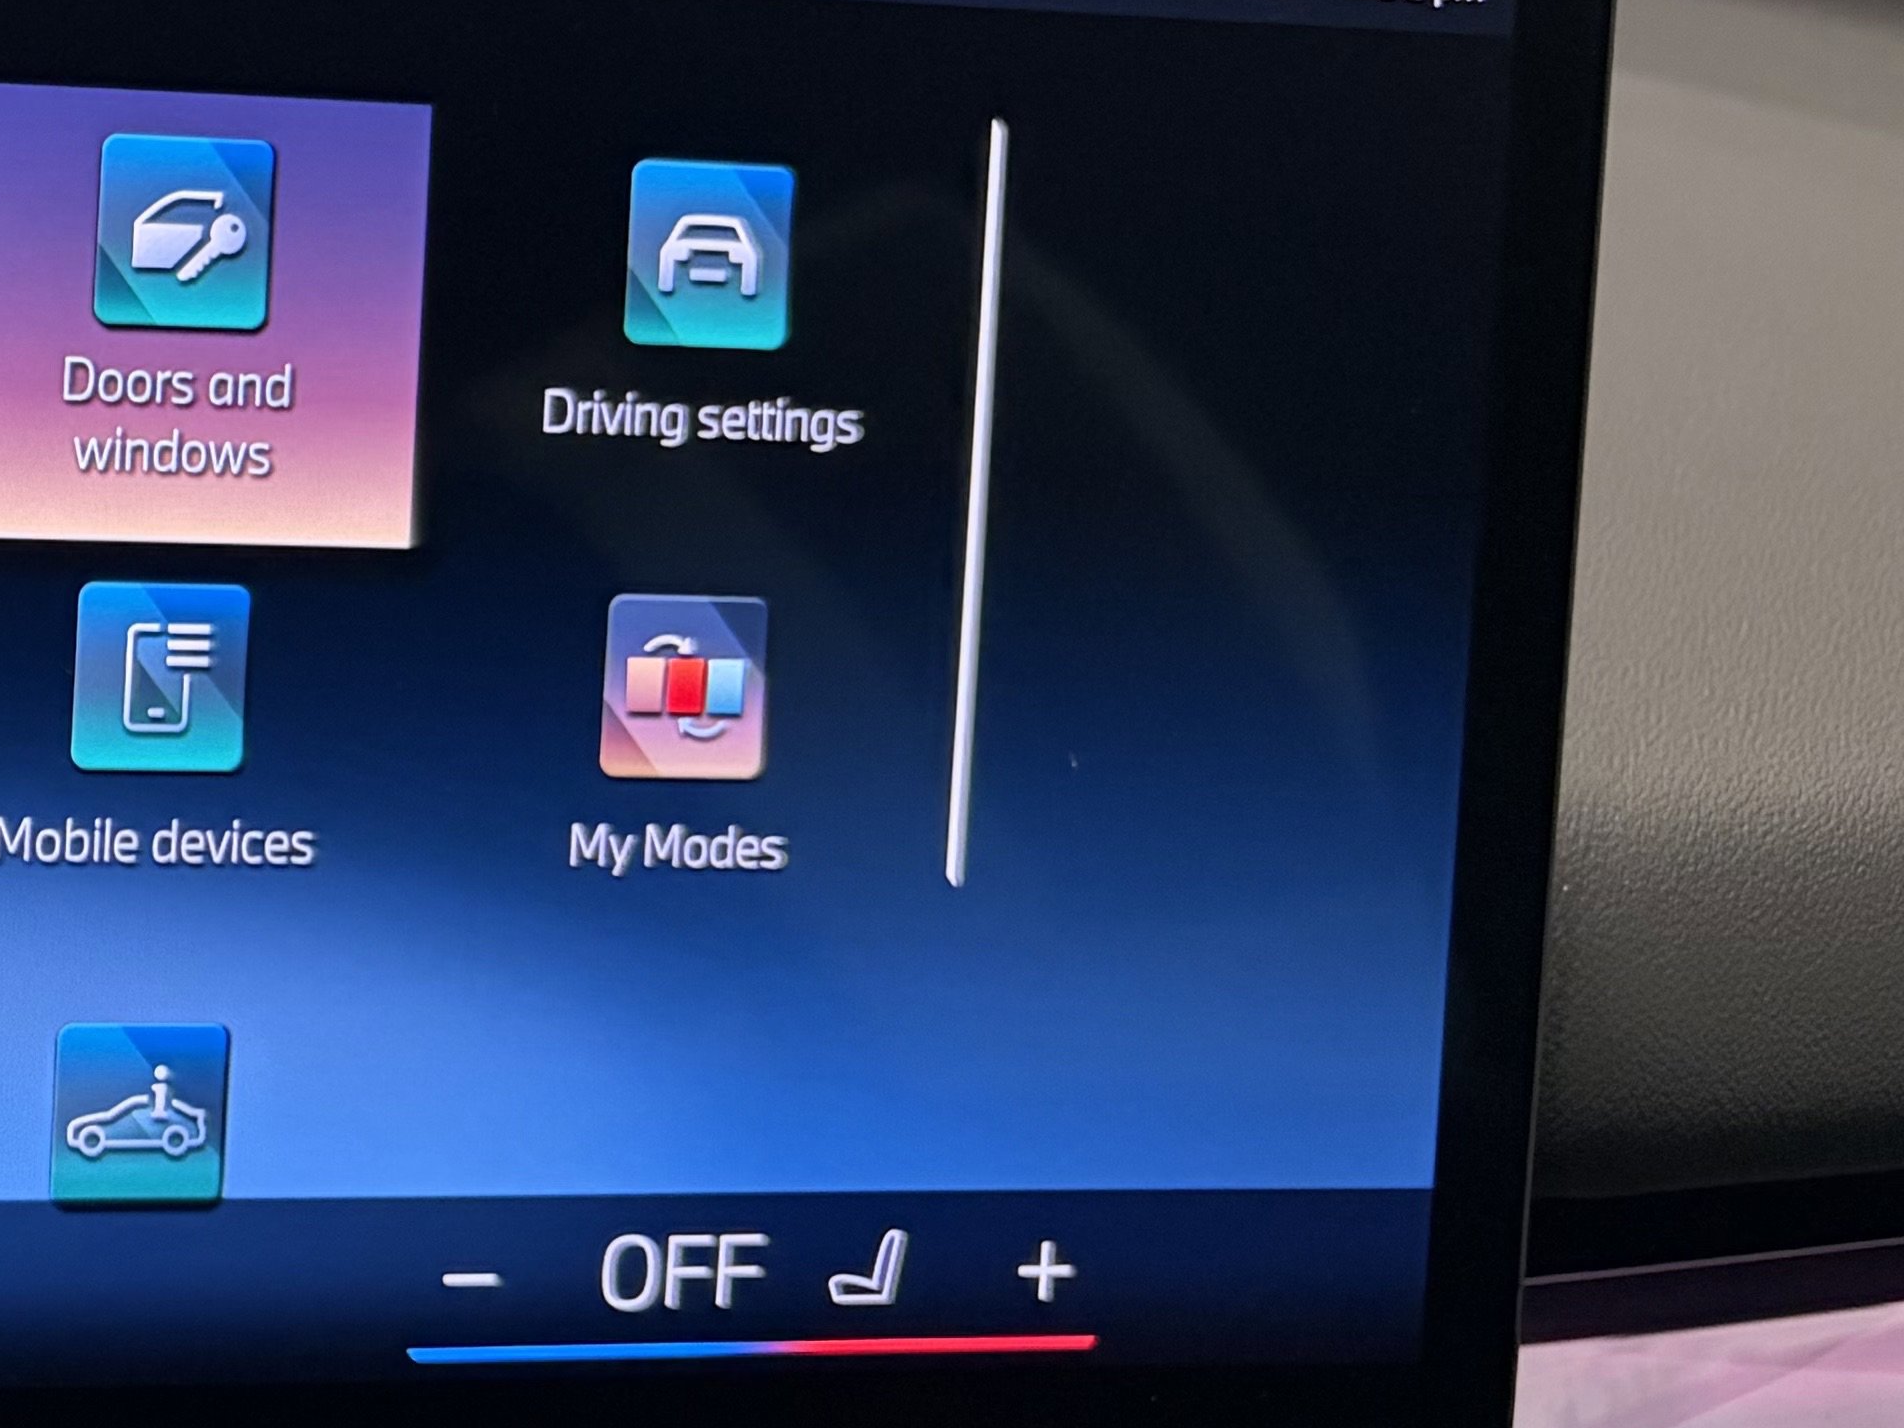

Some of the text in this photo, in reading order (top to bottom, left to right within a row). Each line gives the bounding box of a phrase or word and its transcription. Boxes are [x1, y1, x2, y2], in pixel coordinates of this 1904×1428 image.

[61, 354, 293, 408] Doors and
[541, 386, 865, 454] Driving settings
[70, 429, 275, 479] windows
[150, 817, 316, 866] devices
[568, 821, 789, 878] My Modes
[600, 1232, 770, 1313] OFF
